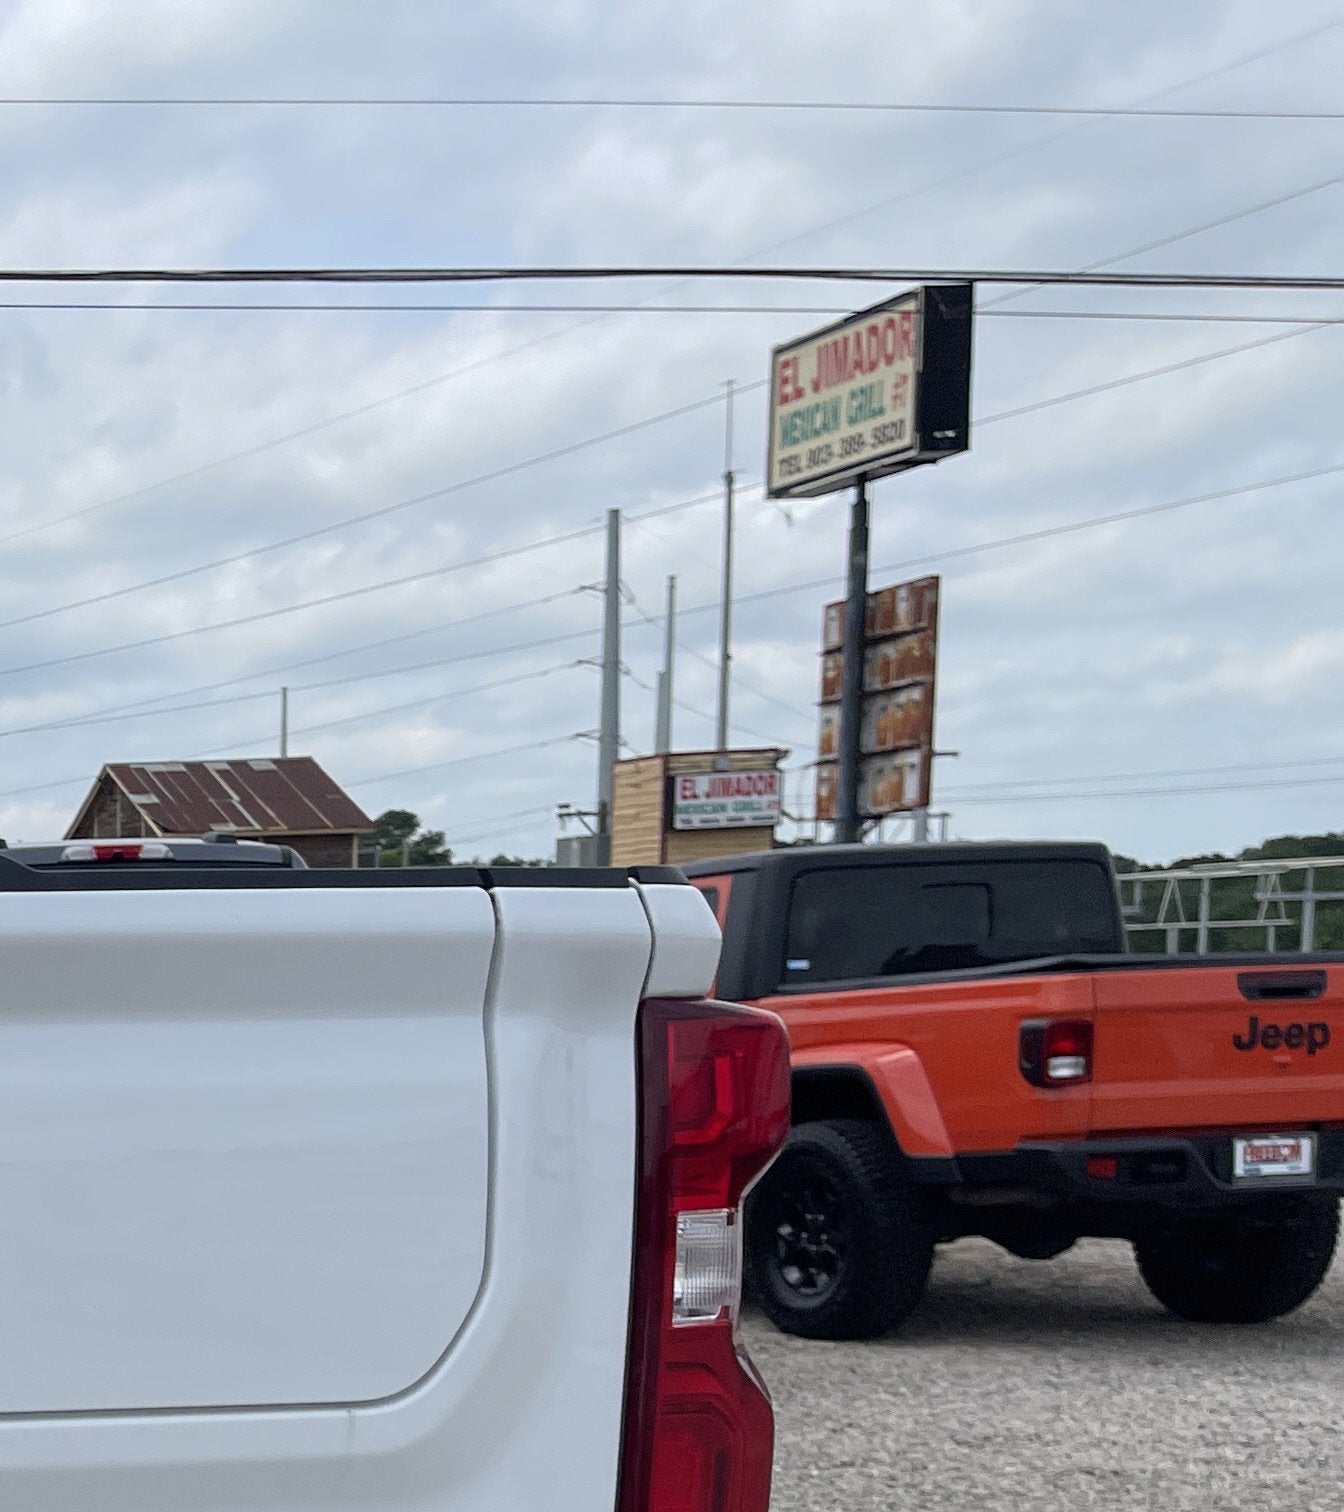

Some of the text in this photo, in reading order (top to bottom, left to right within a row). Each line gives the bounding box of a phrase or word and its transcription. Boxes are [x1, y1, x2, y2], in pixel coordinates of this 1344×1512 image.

[777, 355, 806, 407] EL
[810, 311, 915, 394] JIMADOR
[779, 397, 842, 447] MEXICAN
[846, 380, 886, 427] GRILL
[680, 774, 777, 800] EL JIMADOR
[1232, 1015, 1331, 1056] Jeep
